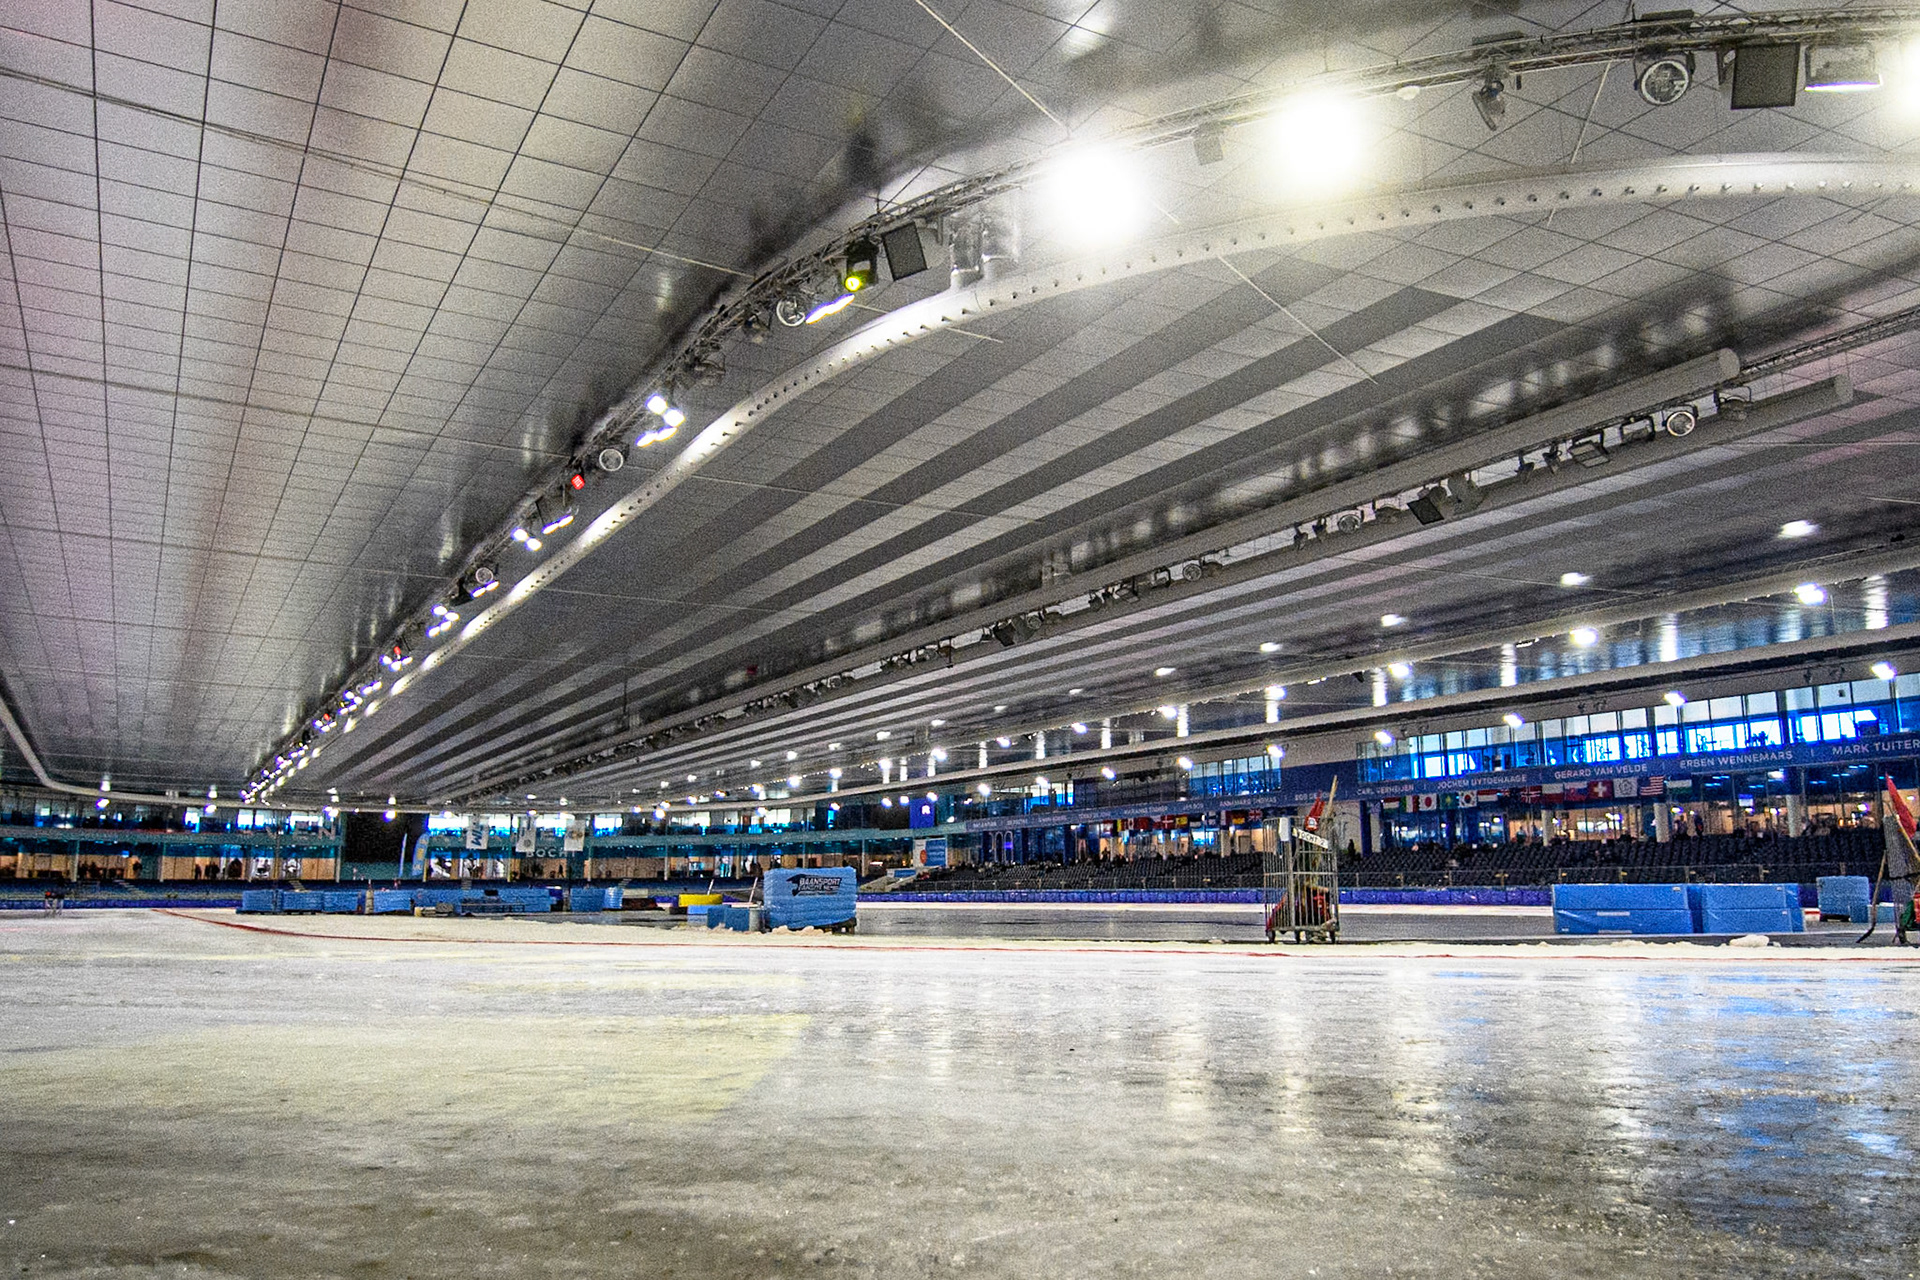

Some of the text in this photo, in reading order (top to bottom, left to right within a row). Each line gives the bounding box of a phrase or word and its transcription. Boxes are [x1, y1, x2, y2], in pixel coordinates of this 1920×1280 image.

[1832, 743, 1870, 755] MARK
[1680, 750, 1793, 769] ERBEN WENNEMARS
[1554, 763, 1648, 780] GERARD VAN VELDE
[1437, 779, 1469, 790] JOCHEM
